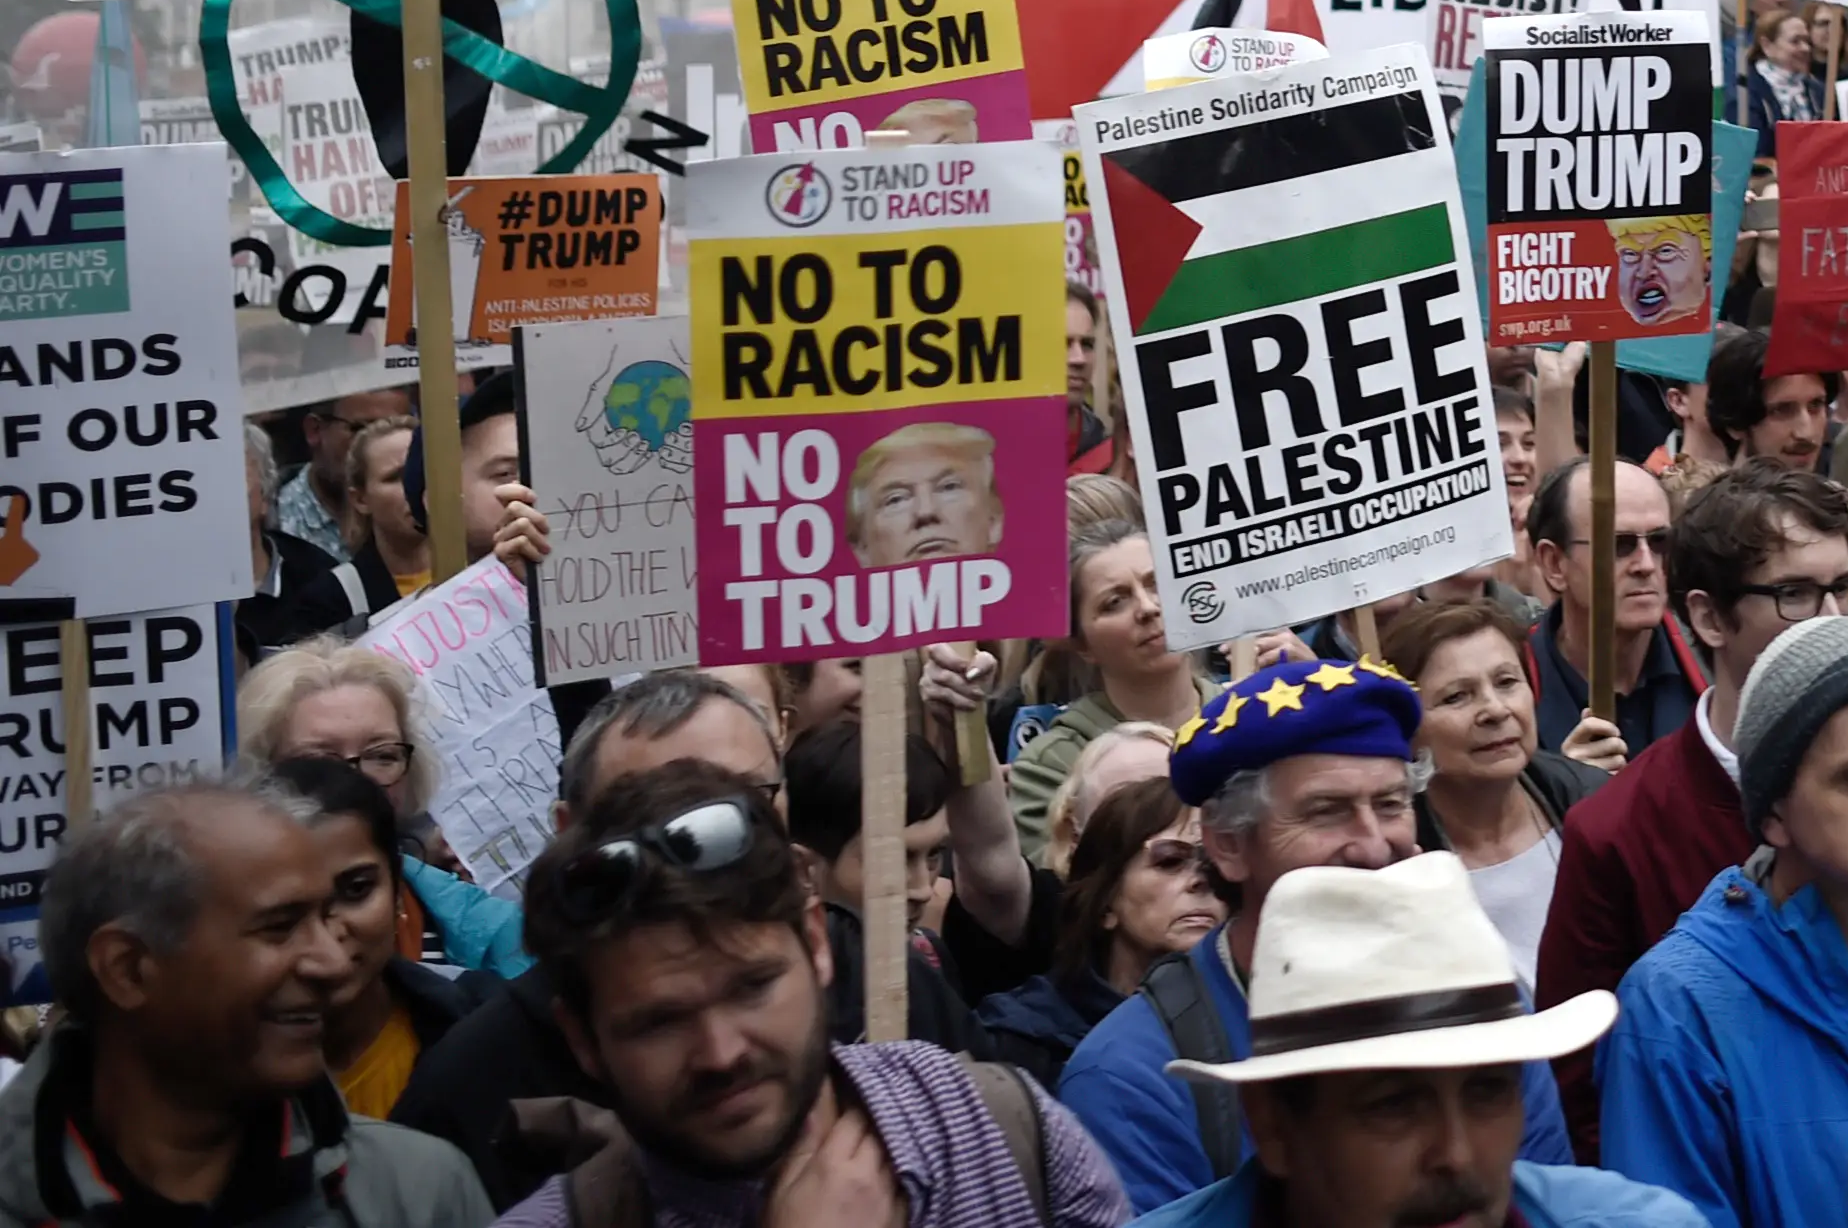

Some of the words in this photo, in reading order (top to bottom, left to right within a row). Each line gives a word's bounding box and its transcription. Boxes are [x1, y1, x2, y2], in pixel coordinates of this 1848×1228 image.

[762, 10, 990, 98] RACISM
[1232, 37, 1276, 57] STAND
[1278, 42, 1296, 57] UP
[1233, 55, 1253, 72] TO
[1525, 24, 1608, 47] Socialist
[1609, 22, 1673, 44] Worker
[1096, 107, 1205, 144] Palestine
[1210, 83, 1317, 121] Solidarity
[1323, 64, 1419, 101] Campaign
[1499, 55, 1673, 135] DUMP
[842, 163, 930, 192] STAND
[936, 159, 976, 187] UP
[1496, 130, 1704, 213] TRUMP
[497, 186, 648, 231] #DUMP
[843, 195, 882, 222] TO
[886, 188, 991, 220] RACISM
[497, 229, 641, 272] TRUMP
[1496, 231, 1576, 269] FIGHT
[483, 294, 592, 317] ANTI-PALESTINE
[592, 292, 652, 310] POLICIES
[719, 250, 834, 326] NO
[858, 243, 961, 319] TO
[1498, 266, 1612, 305] BIGOTRY
[1499, 315, 1573, 337] swp.org.uk
[720, 314, 1023, 401] RACISM
[1135, 269, 1478, 472] FREE
[66, 398, 221, 453] OUR
[723, 428, 841, 504] NO
[1158, 395, 1487, 537] PALESTINE
[557, 488, 622, 542] YOU
[645, 483, 697, 529] CA
[723, 503, 834, 578] TO
[1175, 537, 1232, 576] END
[1239, 510, 1344, 559] ISRAELI
[1348, 463, 1489, 531] OCCUPATION
[540, 554, 612, 608] HOLD
[610, 548, 669, 598] THE
[1235, 522, 1457, 601] www.palestinecampaign.org
[725, 557, 1012, 652] TRUMP
[576, 617, 642, 670] SUCH
[453, 735, 498, 781] IS
